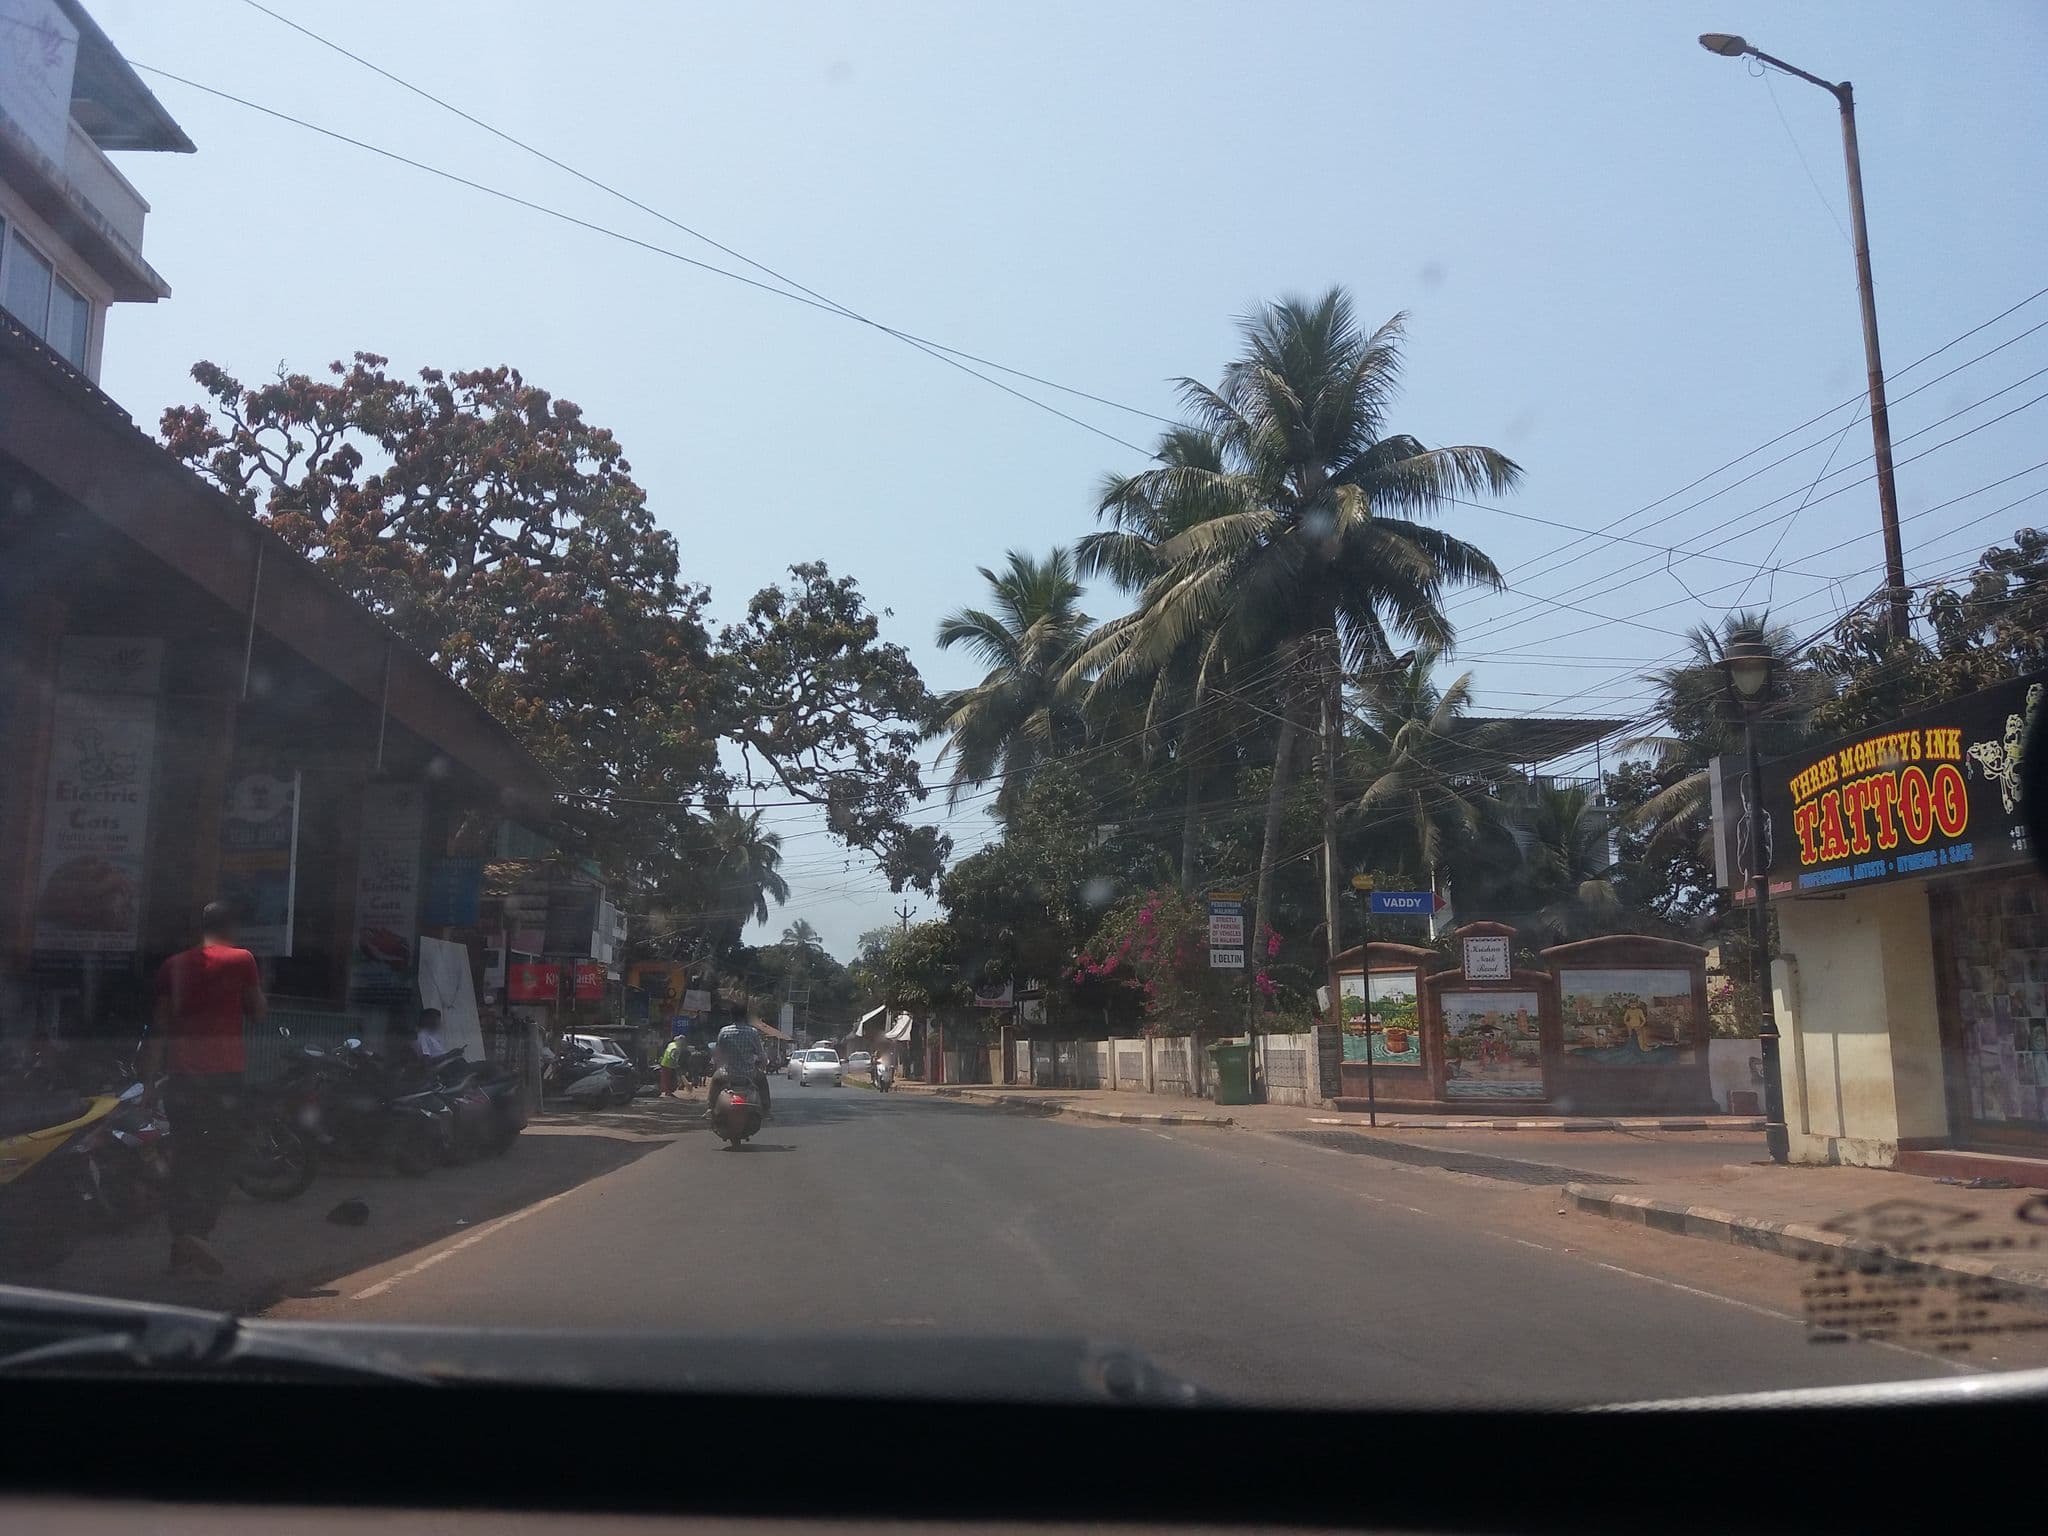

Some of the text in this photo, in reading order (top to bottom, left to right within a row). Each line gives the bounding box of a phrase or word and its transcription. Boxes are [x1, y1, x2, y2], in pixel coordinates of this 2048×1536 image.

[1789, 728, 1962, 804] THREE MONKEYS INK
[56, 780, 137, 802] Electric
[1793, 764, 1968, 865] TATTOO
[1383, 898, 1421, 908] VADDY
[1219, 954, 1242, 963] DELTIN
